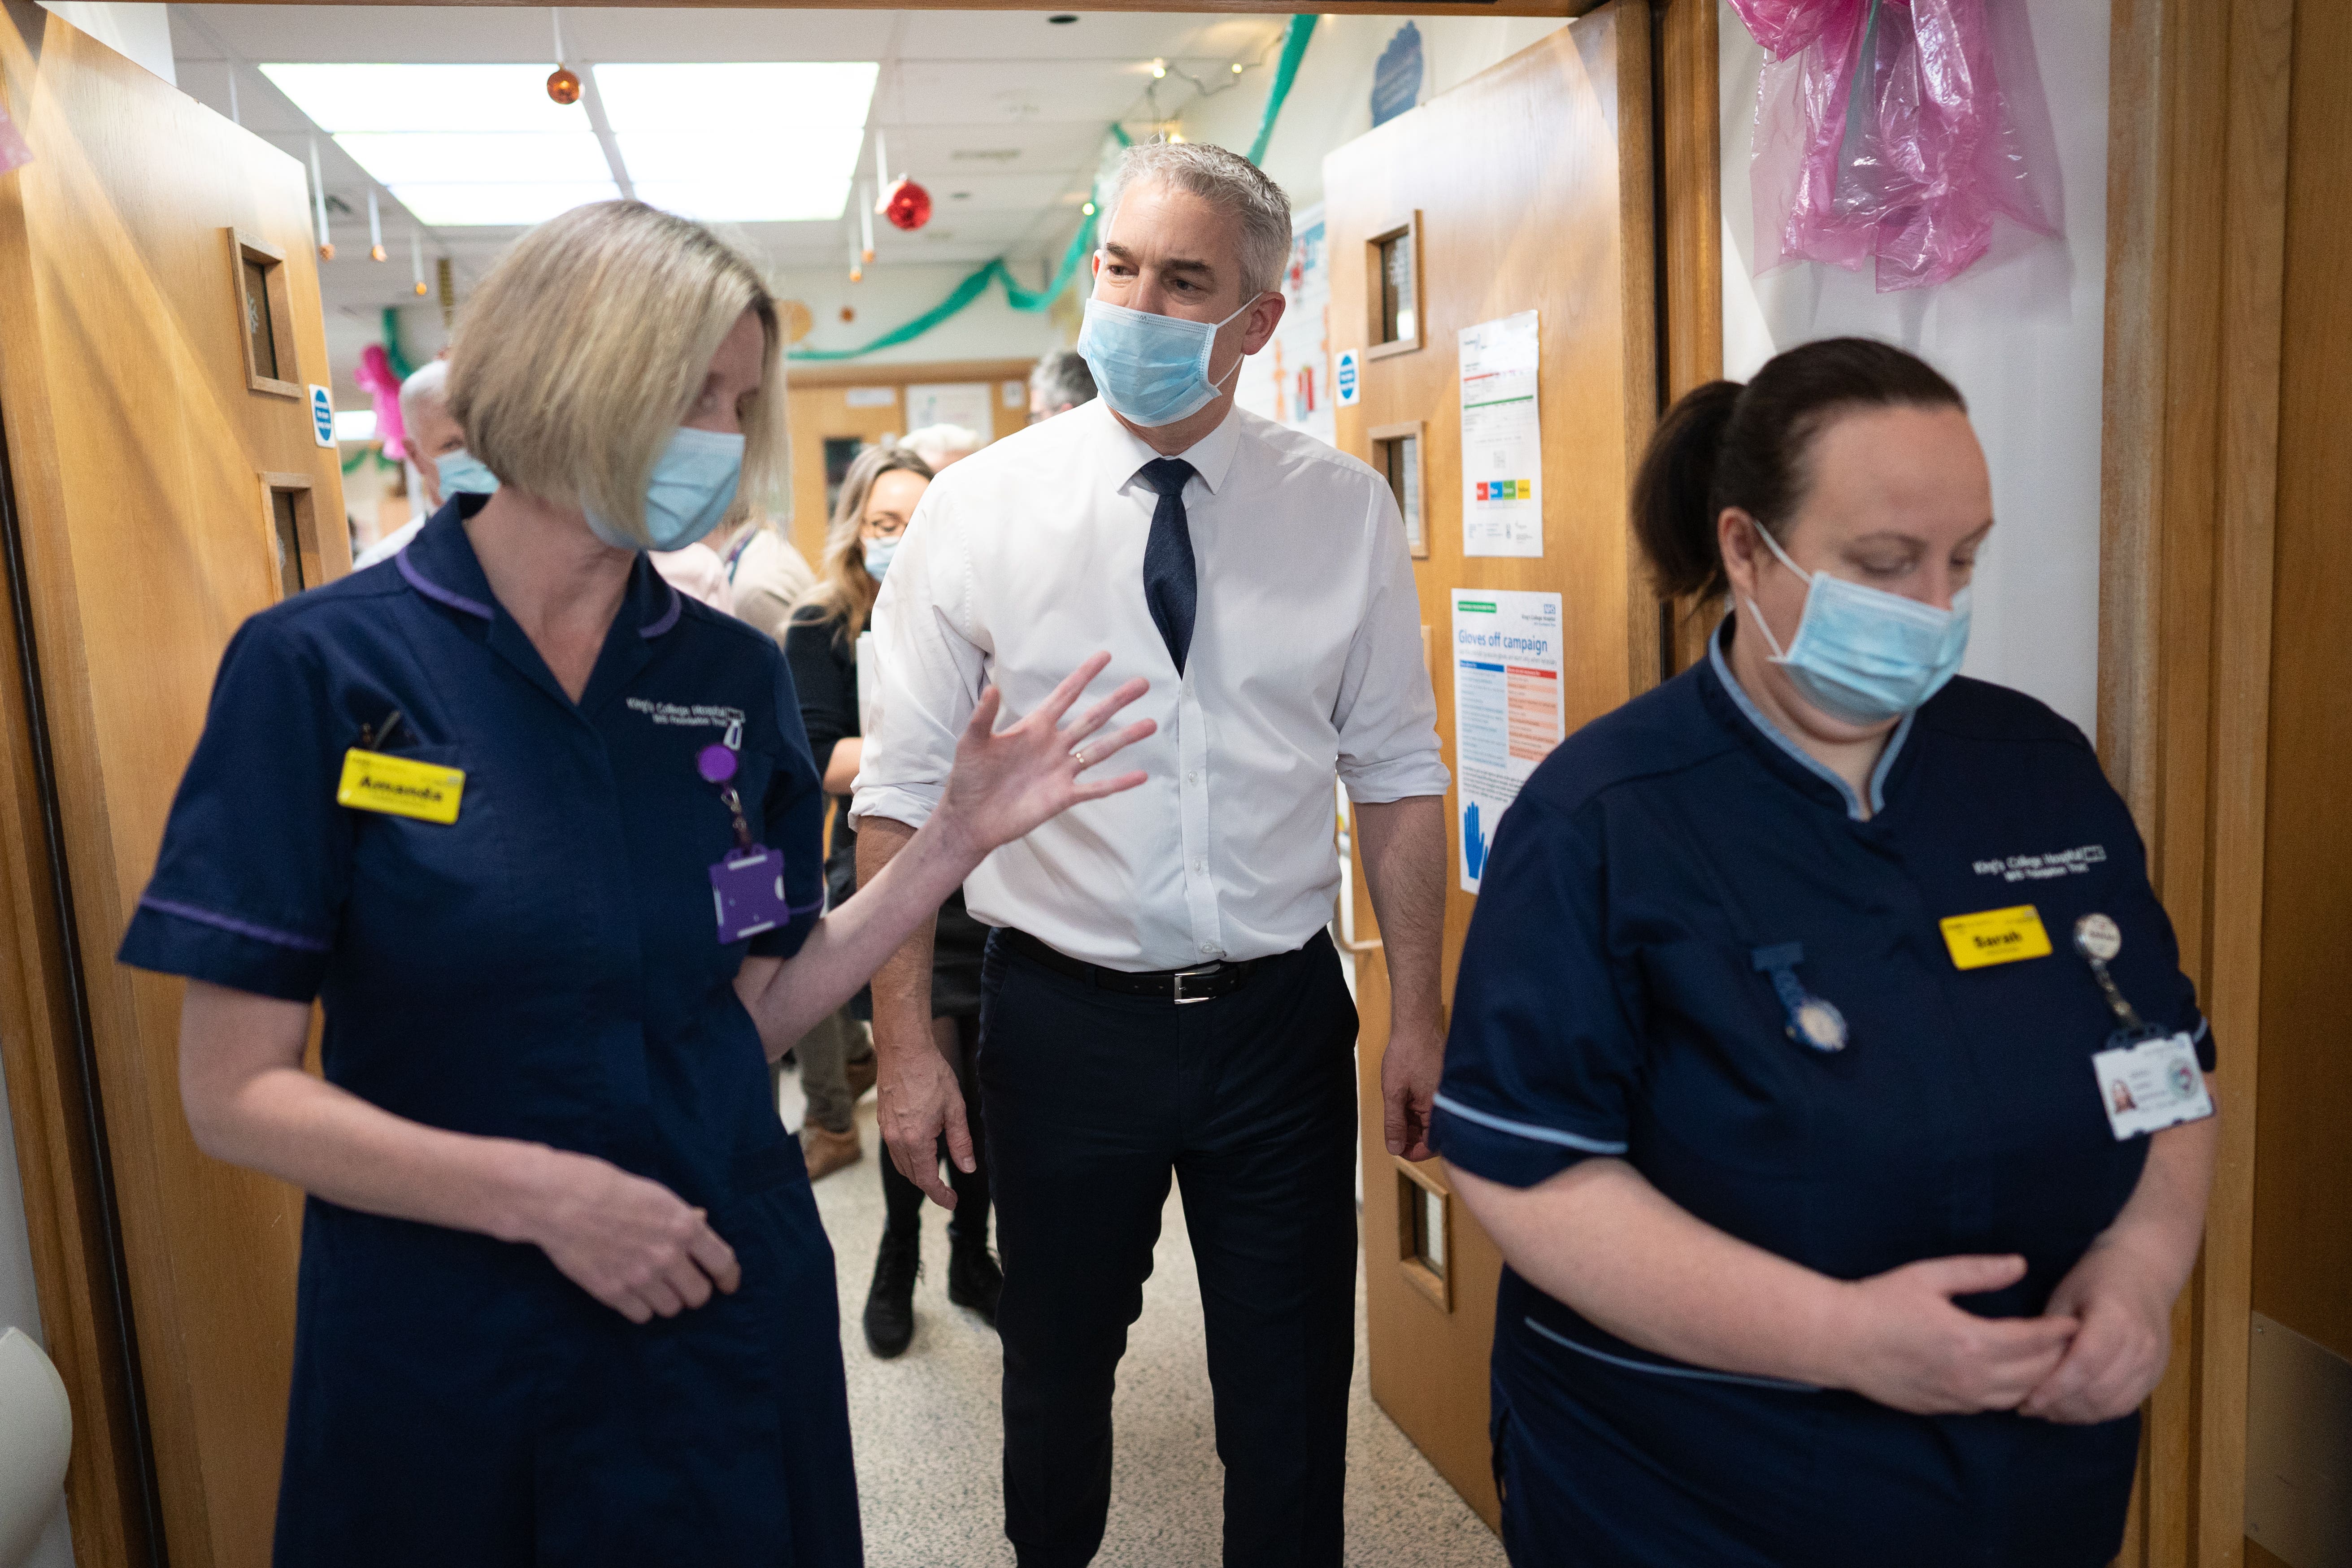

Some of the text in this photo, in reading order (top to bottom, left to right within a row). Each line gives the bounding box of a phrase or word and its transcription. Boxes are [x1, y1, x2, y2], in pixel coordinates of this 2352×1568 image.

[1458, 629, 1548, 655] Gloves off campaign
[360, 775, 442, 802] Amanda
[1974, 931, 2022, 949] Sarah
